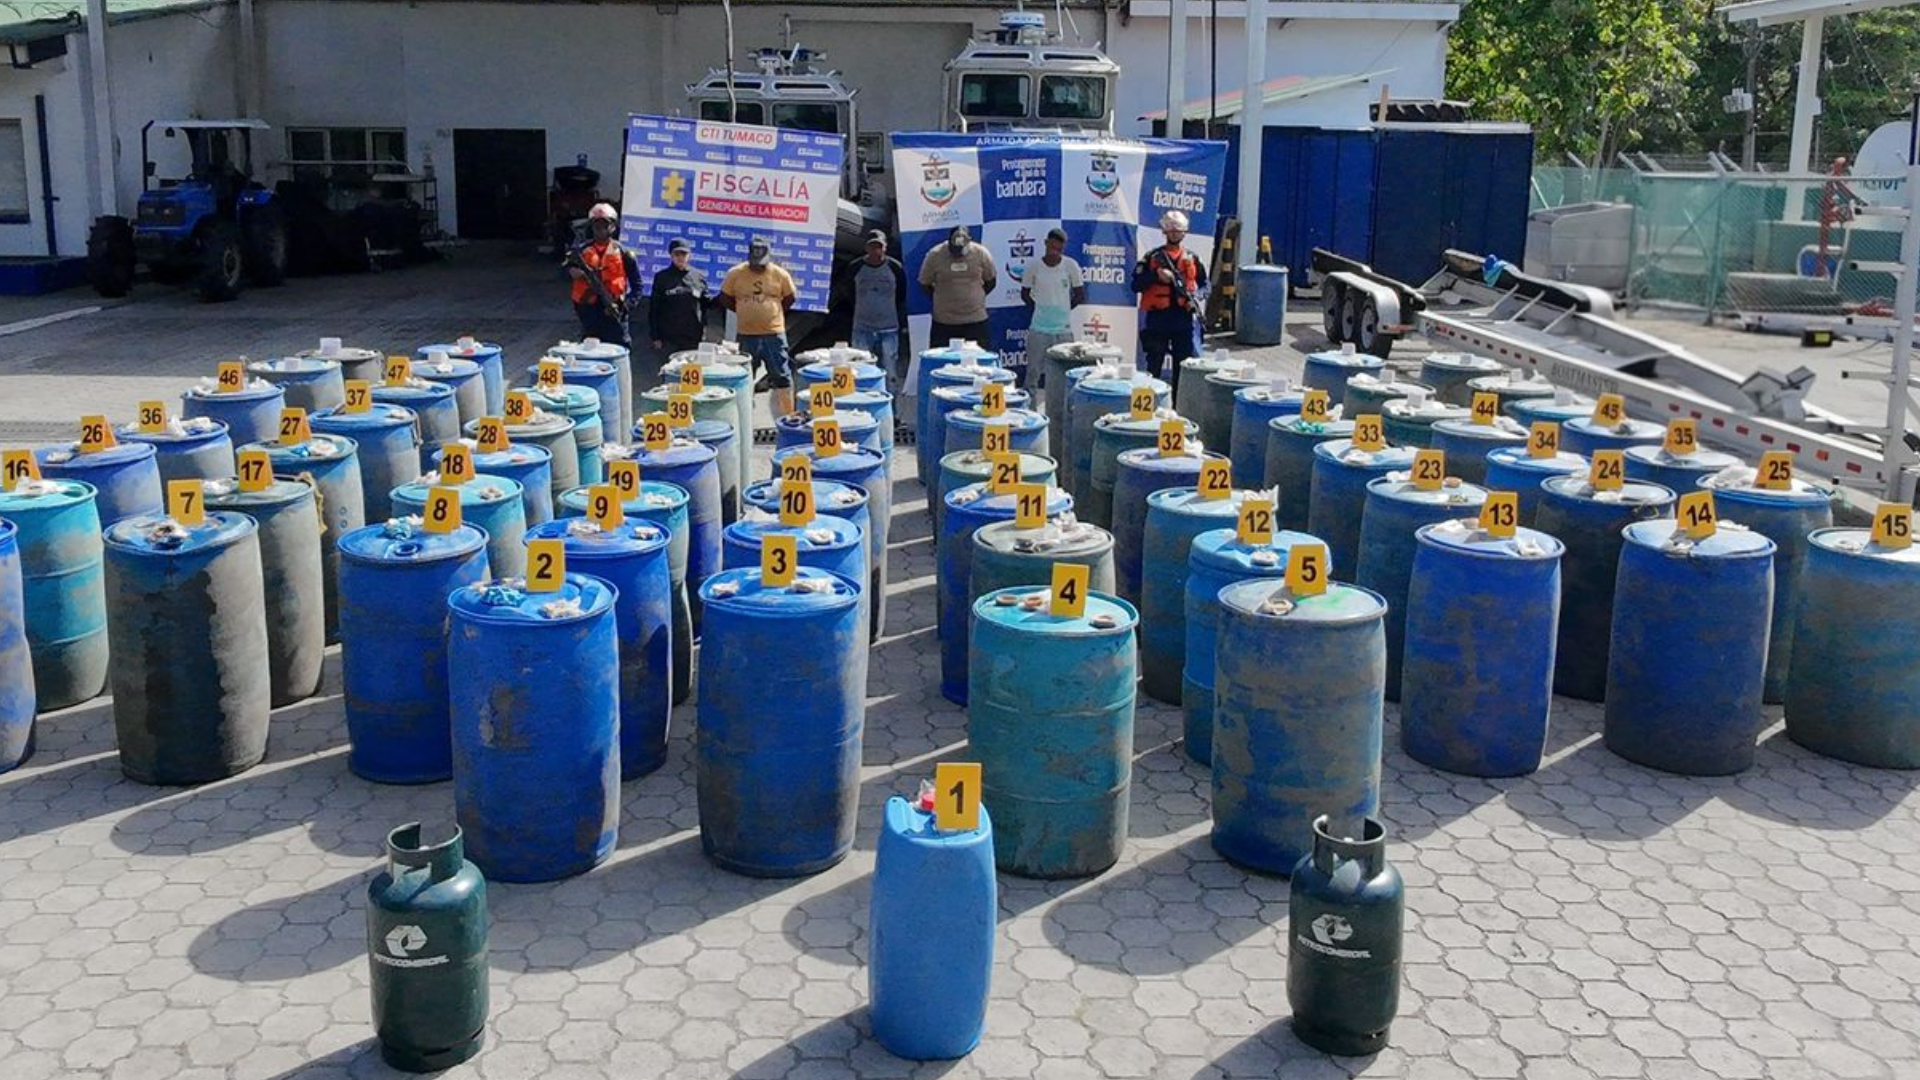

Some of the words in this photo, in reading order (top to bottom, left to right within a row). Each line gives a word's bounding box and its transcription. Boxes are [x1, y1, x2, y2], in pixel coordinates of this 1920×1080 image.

[701, 128, 719, 138] CTI
[723, 129, 773, 145] TUMACO
[976, 137, 1024, 146] ARMADA
[699, 171, 810, 200] FISCALÍA
[996, 180, 1046, 199] bandera
[699, 200, 742, 214] GENERAL
[744, 204, 757, 215] DE
[758, 206, 770, 216] LA
[1153, 187, 1204, 213] bandera
[1081, 266, 1126, 284] andera
[999, 349, 1029, 367] band
[219, 369, 238, 385] 46
[387, 365, 404, 379] 47
[539, 369, 557, 384] 48
[681, 370, 699, 384] 49
[832, 374, 848, 389] 50
[346, 389, 365, 406] 37
[813, 391, 833, 407] 40
[979, 392, 999, 409] 41
[1132, 395, 1152, 412] 42
[141, 407, 162, 425] 36
[505, 398, 523, 417] 38
[670, 401, 688, 419] 39
[1306, 399, 1325, 416] 43
[1475, 400, 1495, 417] 44
[1601, 403, 1620, 420] 45
[82, 425, 103, 443] 26
[280, 416, 301, 436] 27
[479, 425, 498, 443] 28
[646, 423, 666, 442] 29
[1360, 424, 1379, 442] 33
[816, 428, 837, 448] 30
[986, 432, 1005, 452] 31
[1162, 432, 1182, 451] 32
[1535, 431, 1556, 449] 34
[1674, 427, 1694, 446] 35
[5, 460, 29, 480] 16
[240, 460, 264, 481] 17
[441, 453, 464, 475] 18
[1418, 459, 1441, 480] 23
[1598, 459, 1621, 480] 24
[1768, 460, 1791, 481] 25
[611, 471, 633, 492] 19
[783, 467, 807, 481] 20
[997, 464, 1019, 484] 21
[1207, 469, 1229, 490] 22
[180, 491, 195, 514] 7
[432, 498, 448, 522] 8
[595, 498, 609, 520] 9
[783, 491, 807, 515] 10
[1019, 495, 1042, 517] 11
[1245, 511, 1271, 533] 12
[1489, 503, 1514, 526] 13
[1686, 502, 1713, 527] 14
[1881, 514, 1908, 537] 15
[535, 553, 553, 580] 2
[771, 548, 787, 575] 3
[1301, 556, 1317, 583] 5
[1059, 578, 1077, 605] 4
[949, 781, 964, 814] 1
